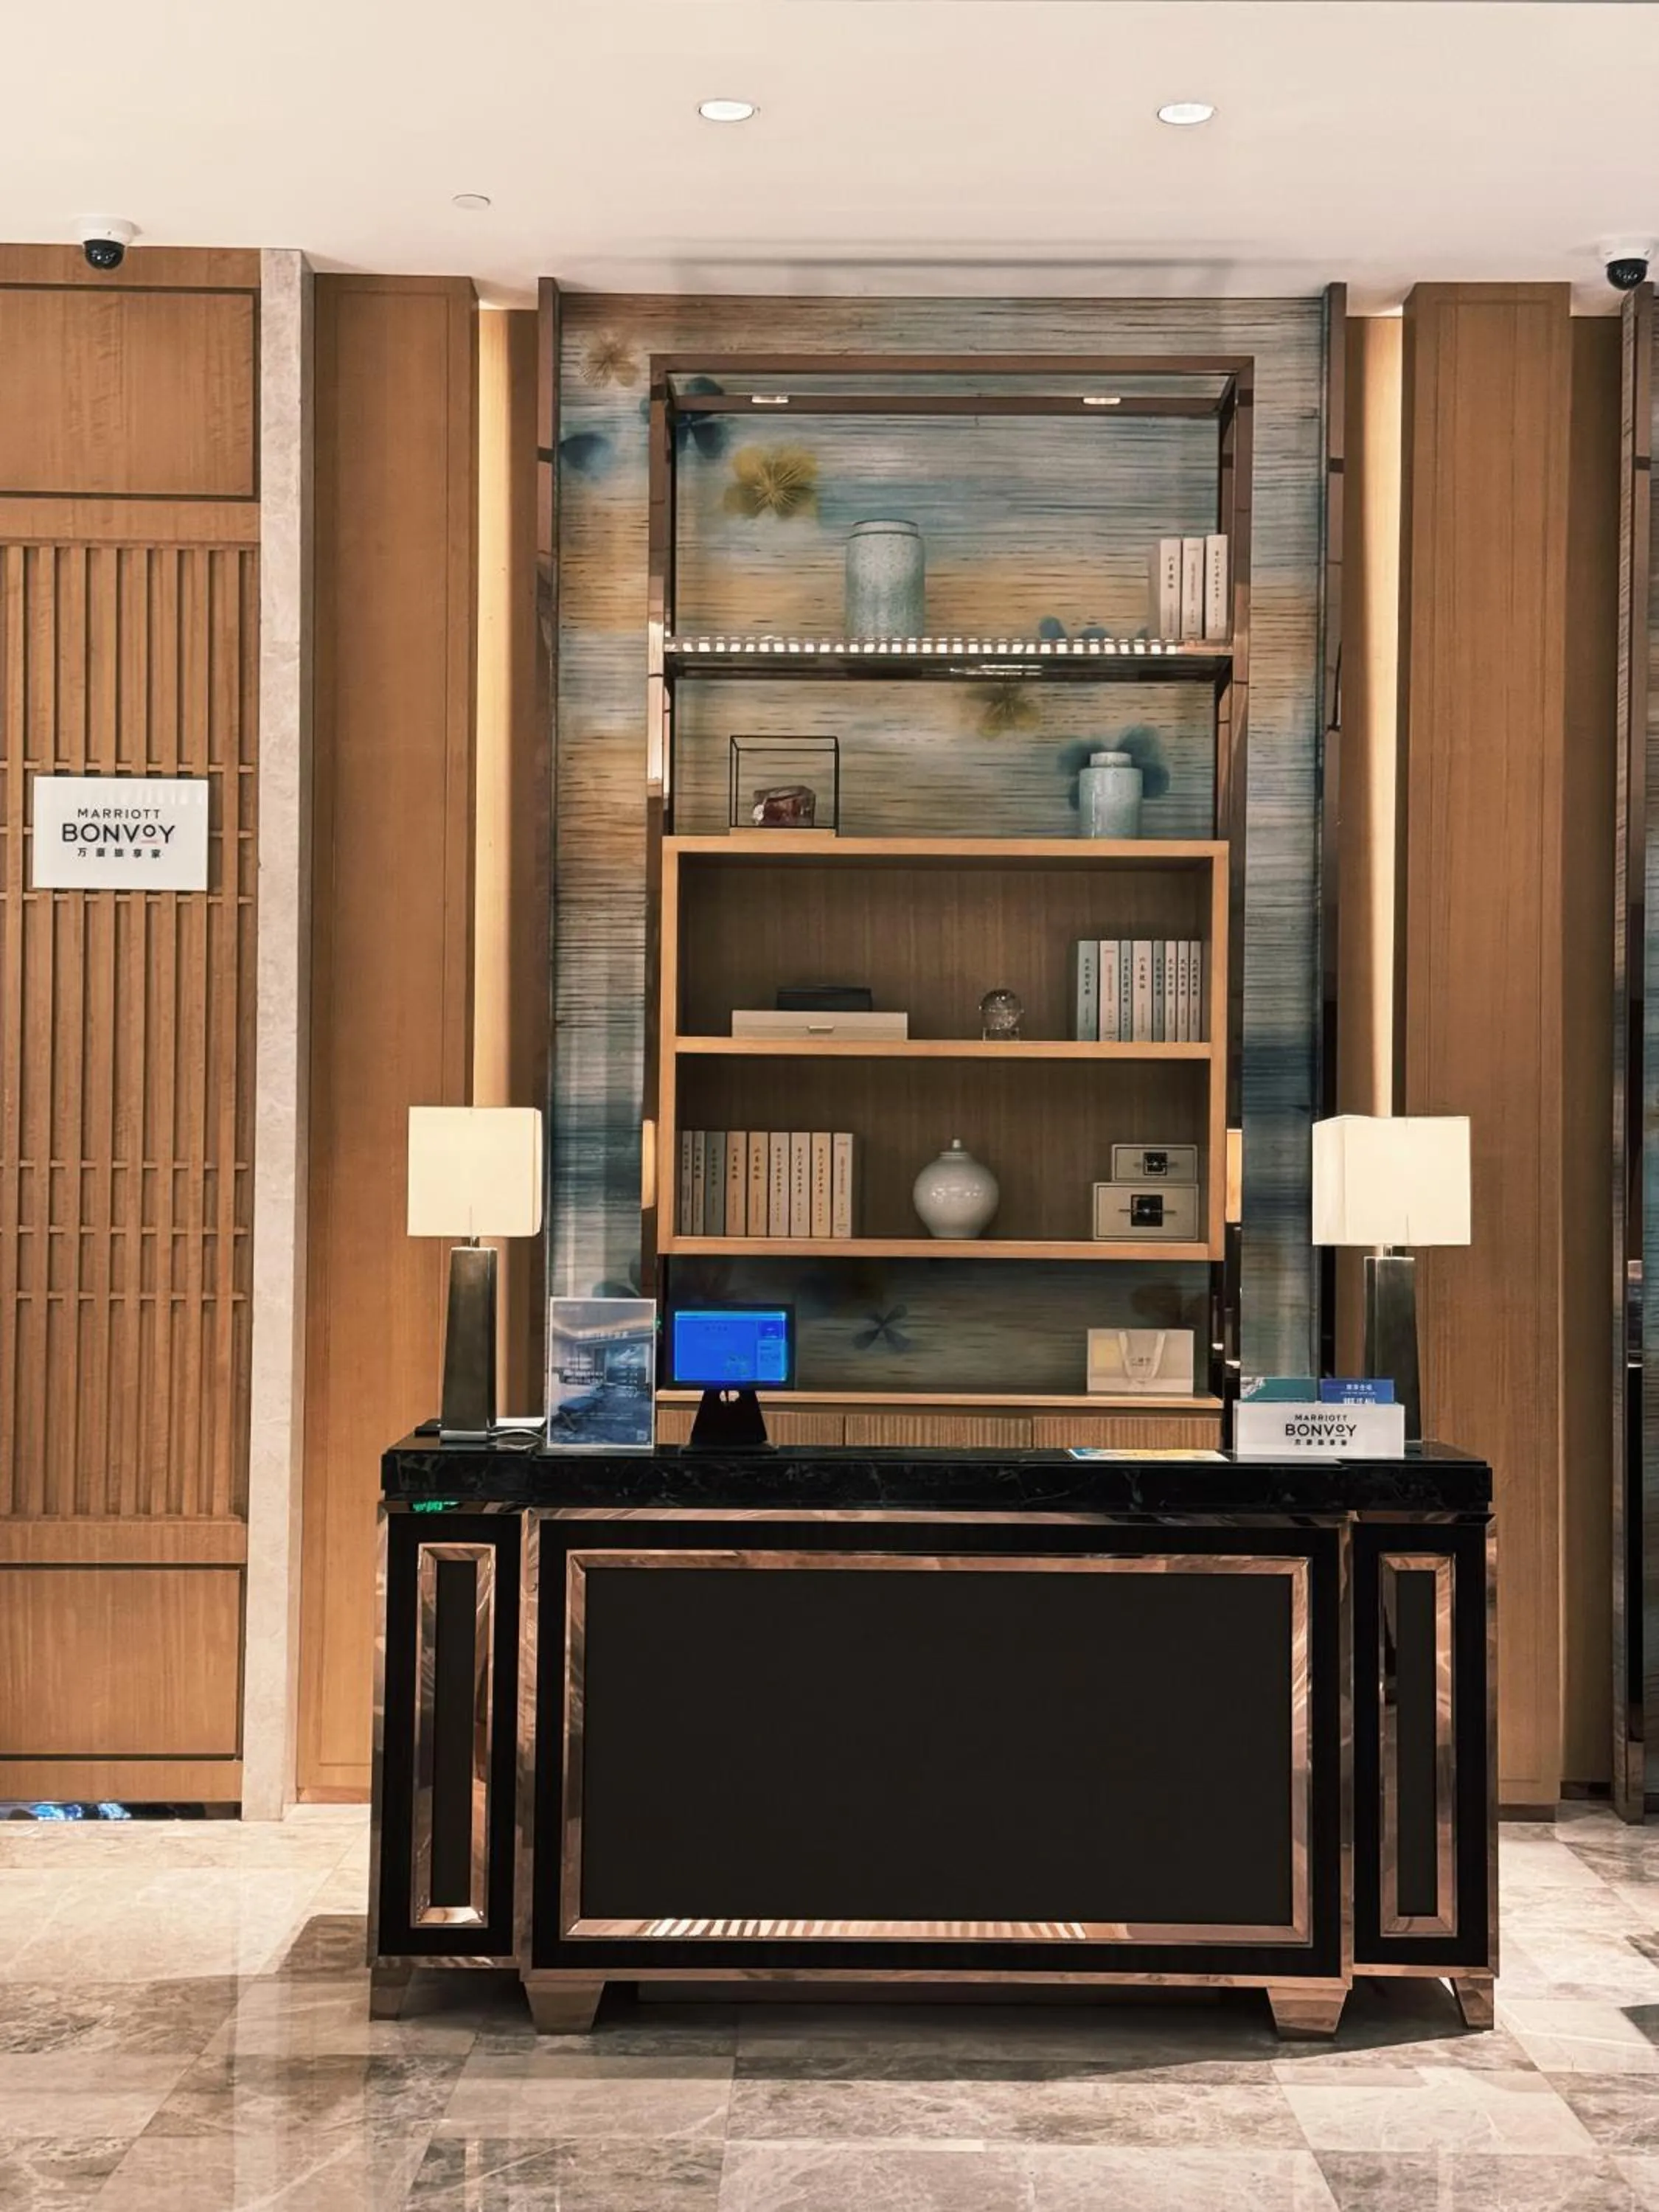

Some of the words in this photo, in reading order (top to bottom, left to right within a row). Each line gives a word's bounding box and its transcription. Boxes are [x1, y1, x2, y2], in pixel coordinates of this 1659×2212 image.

[77, 808, 161, 819] MARRIOTT
[62, 823, 175, 844] BONVOY
[1285, 1424, 1357, 1437] BONVOY
